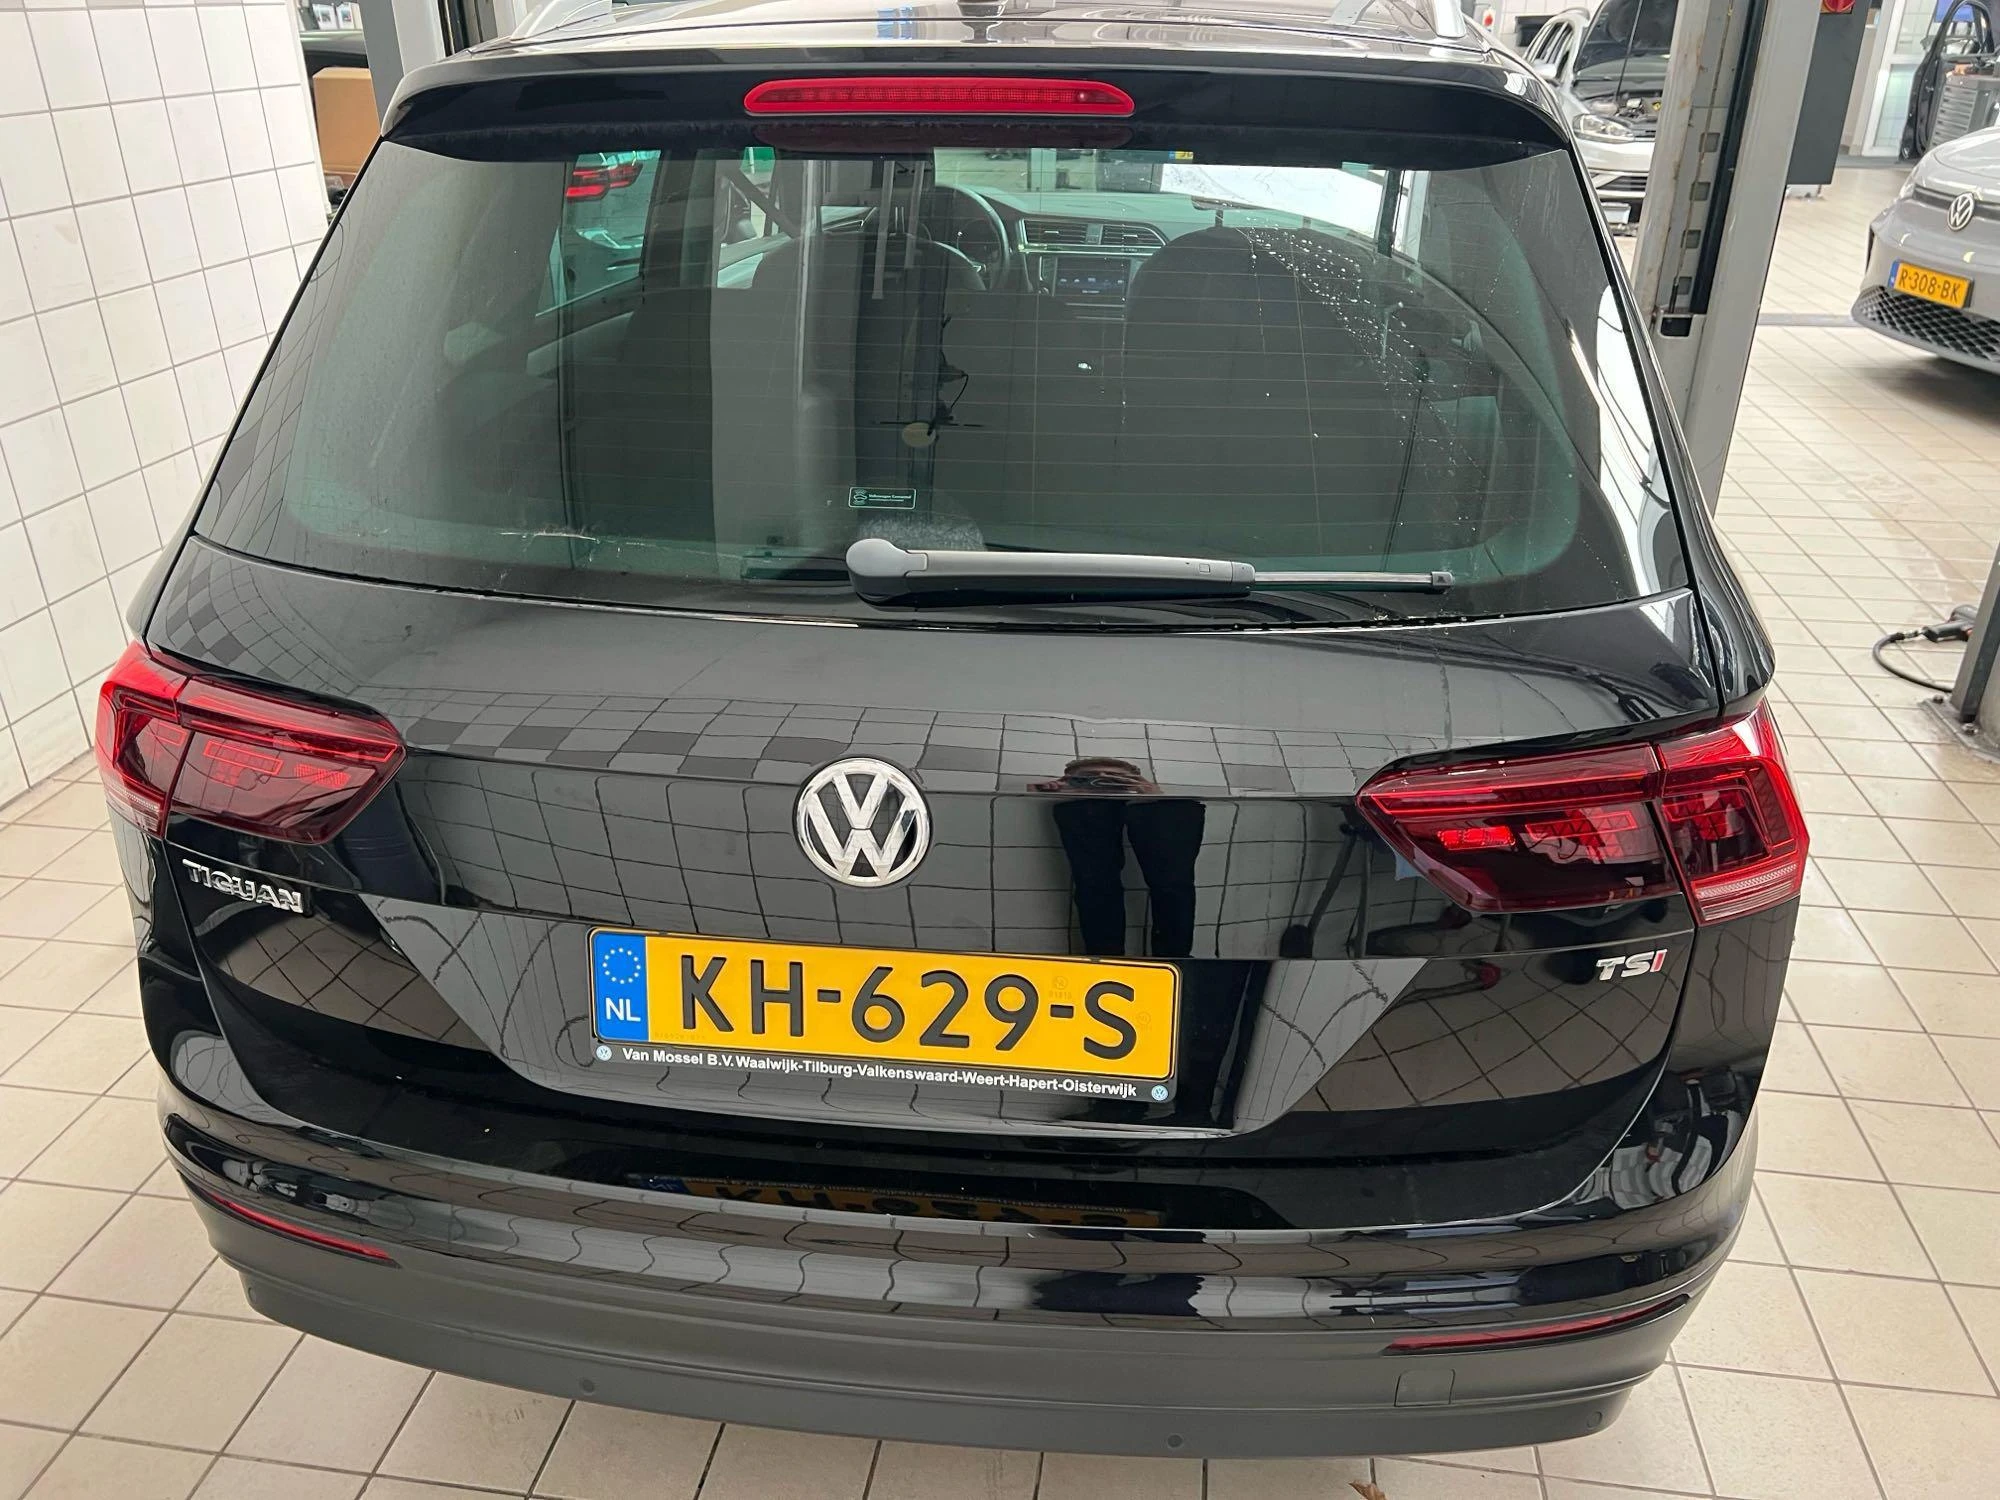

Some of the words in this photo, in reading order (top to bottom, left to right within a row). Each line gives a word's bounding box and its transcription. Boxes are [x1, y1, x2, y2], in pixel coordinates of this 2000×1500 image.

[1898, 268, 1962, 304] R-308-BK
[182, 858, 304, 914] TIGUAN
[1596, 948, 1668, 981] TSI
[605, 997, 642, 1023] NL
[680, 953, 1137, 1060] KH-629-S
[622, 1047, 650, 1062] Van
[653, 1050, 703, 1065] Mossel
